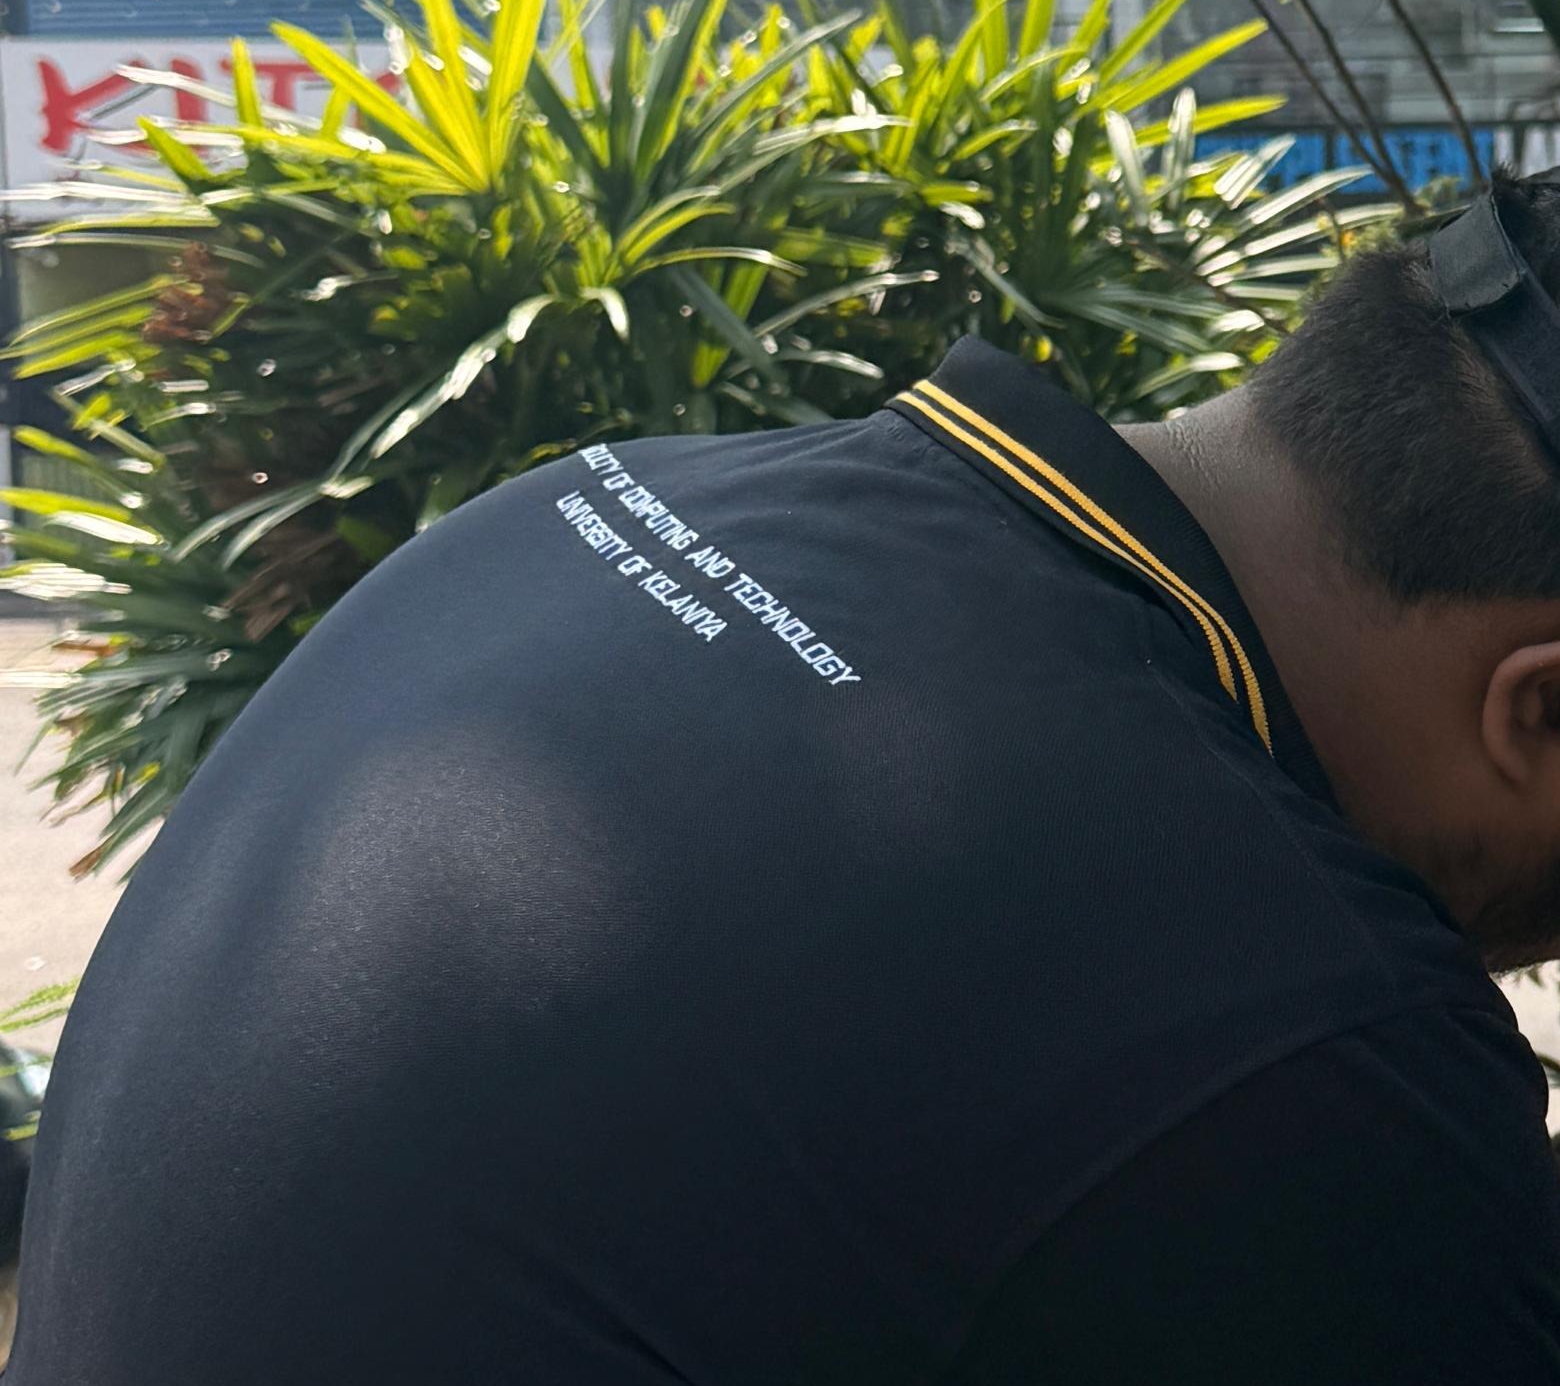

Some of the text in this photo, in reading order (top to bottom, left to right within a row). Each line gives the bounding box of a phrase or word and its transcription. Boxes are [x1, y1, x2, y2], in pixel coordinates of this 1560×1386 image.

[556, 490, 728, 643] UNIVERSITY OF KELANIYA
[618, 485, 700, 551] COMPUTING
[684, 545, 737, 579] AND
[724, 573, 863, 685] TECHNOLOGY
